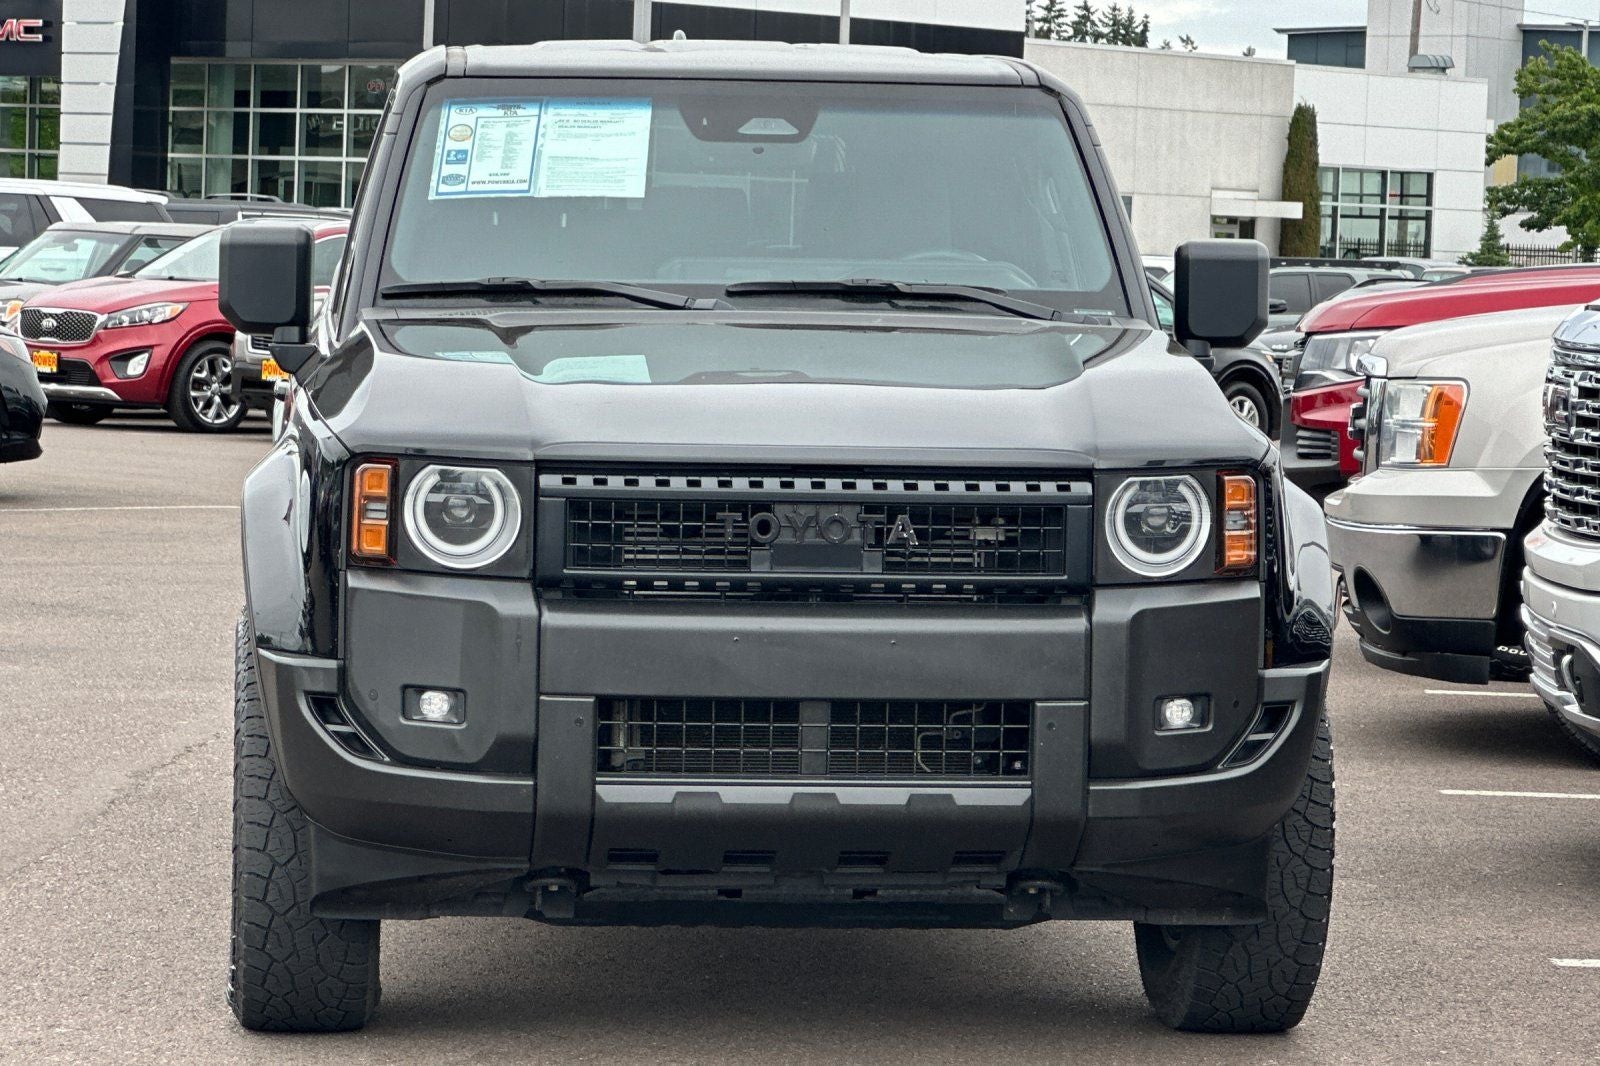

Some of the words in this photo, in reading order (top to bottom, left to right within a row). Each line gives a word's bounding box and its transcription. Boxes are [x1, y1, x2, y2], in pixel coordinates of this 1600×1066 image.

[0, 19, 43, 42] MC
[367, 81, 385, 91] OPEN
[34, 354, 57, 367] POWER
[263, 363, 286, 376] POWE
[716, 512, 918, 545] TOYOTA
